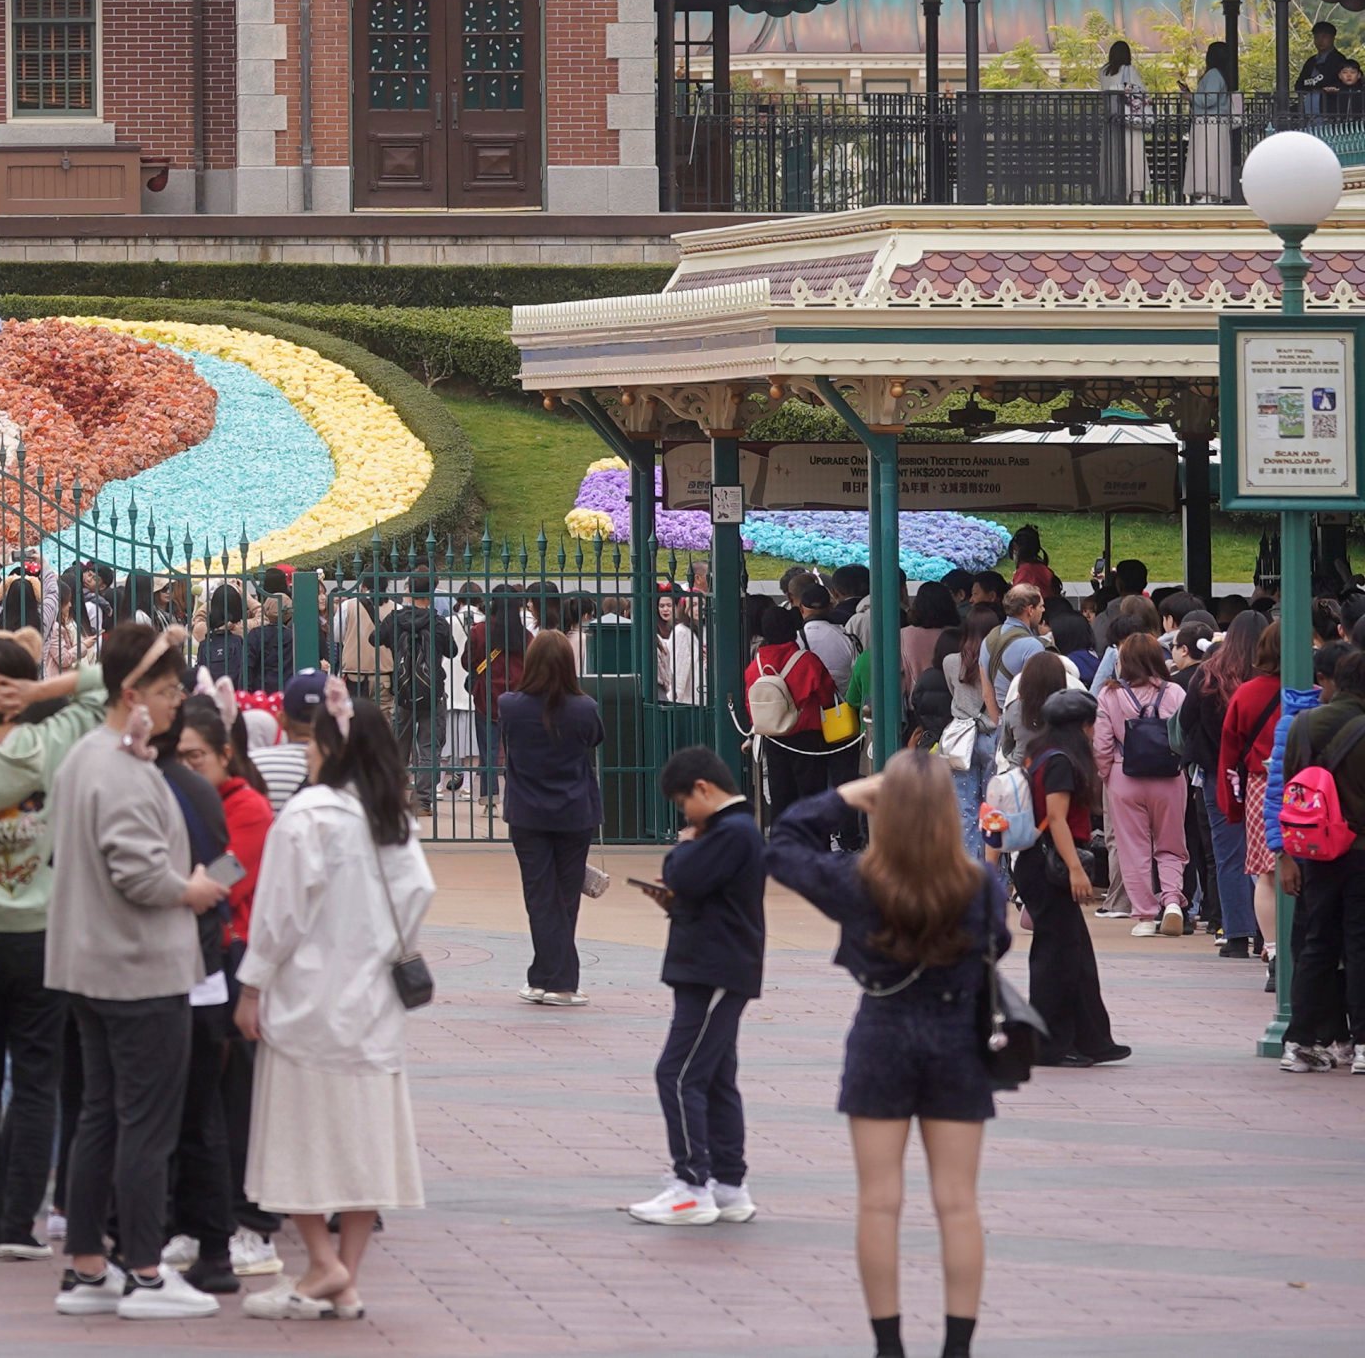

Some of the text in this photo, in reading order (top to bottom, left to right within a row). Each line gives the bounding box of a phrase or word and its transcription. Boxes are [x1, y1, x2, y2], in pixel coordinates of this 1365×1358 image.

[809, 456, 850, 466] UPGRADE
[930, 456, 959, 466] TICKET
[960, 457, 971, 466] TO
[972, 456, 1007, 466] ANNUAL
[1008, 456, 1030, 466] PASS
[909, 467, 946, 478] HK$200
[947, 467, 990, 478] DISCOUNT
